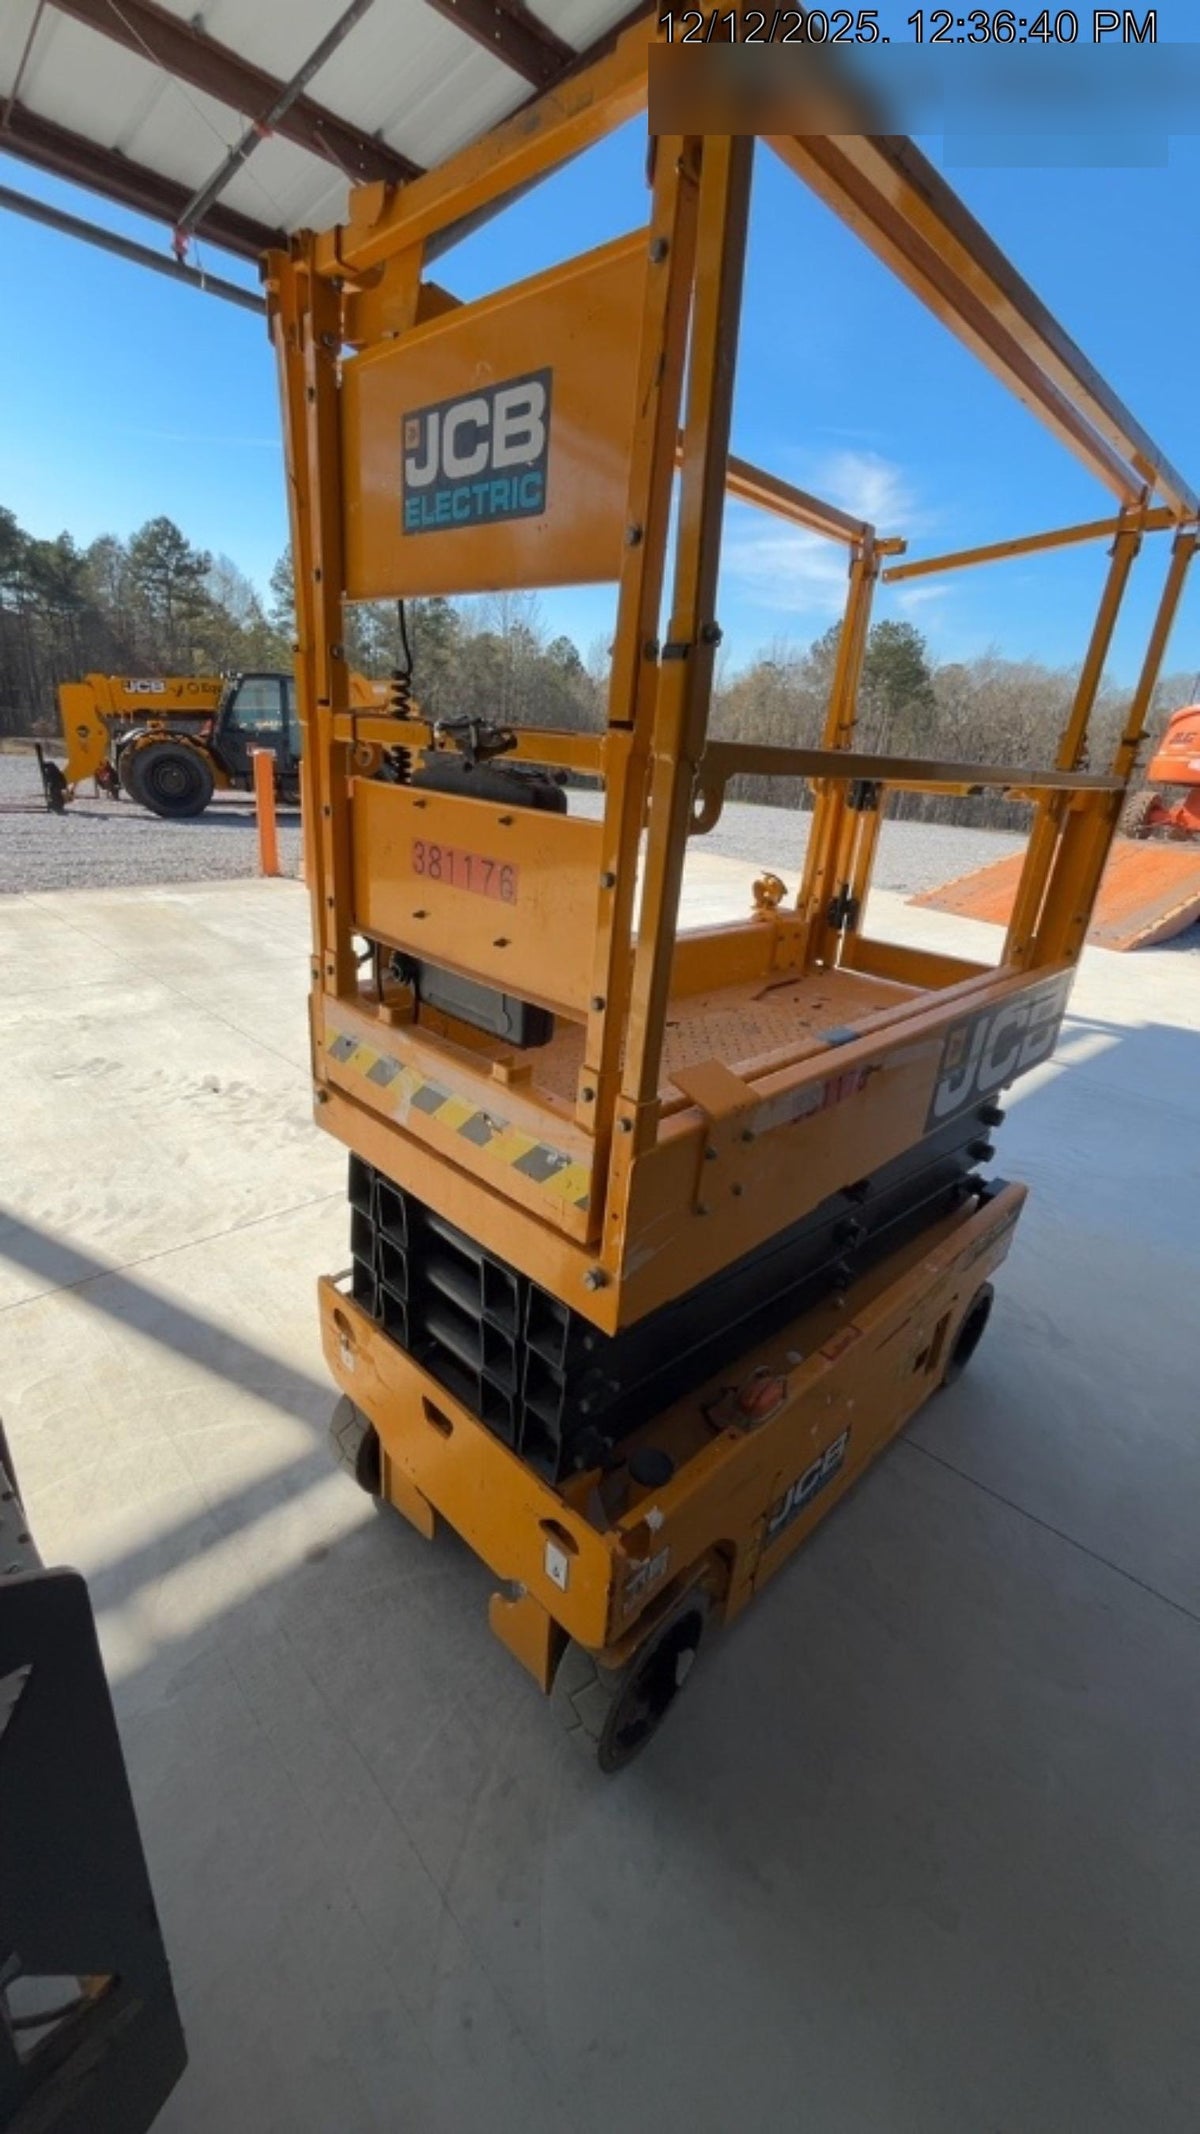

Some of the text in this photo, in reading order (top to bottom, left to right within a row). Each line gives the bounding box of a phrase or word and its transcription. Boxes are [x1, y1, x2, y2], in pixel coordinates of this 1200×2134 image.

[405, 381, 546, 488] JCB
[405, 472, 542, 528] ELECTRIC
[935, 991, 1063, 1116] JCB
[768, 1431, 849, 1532] JCB
